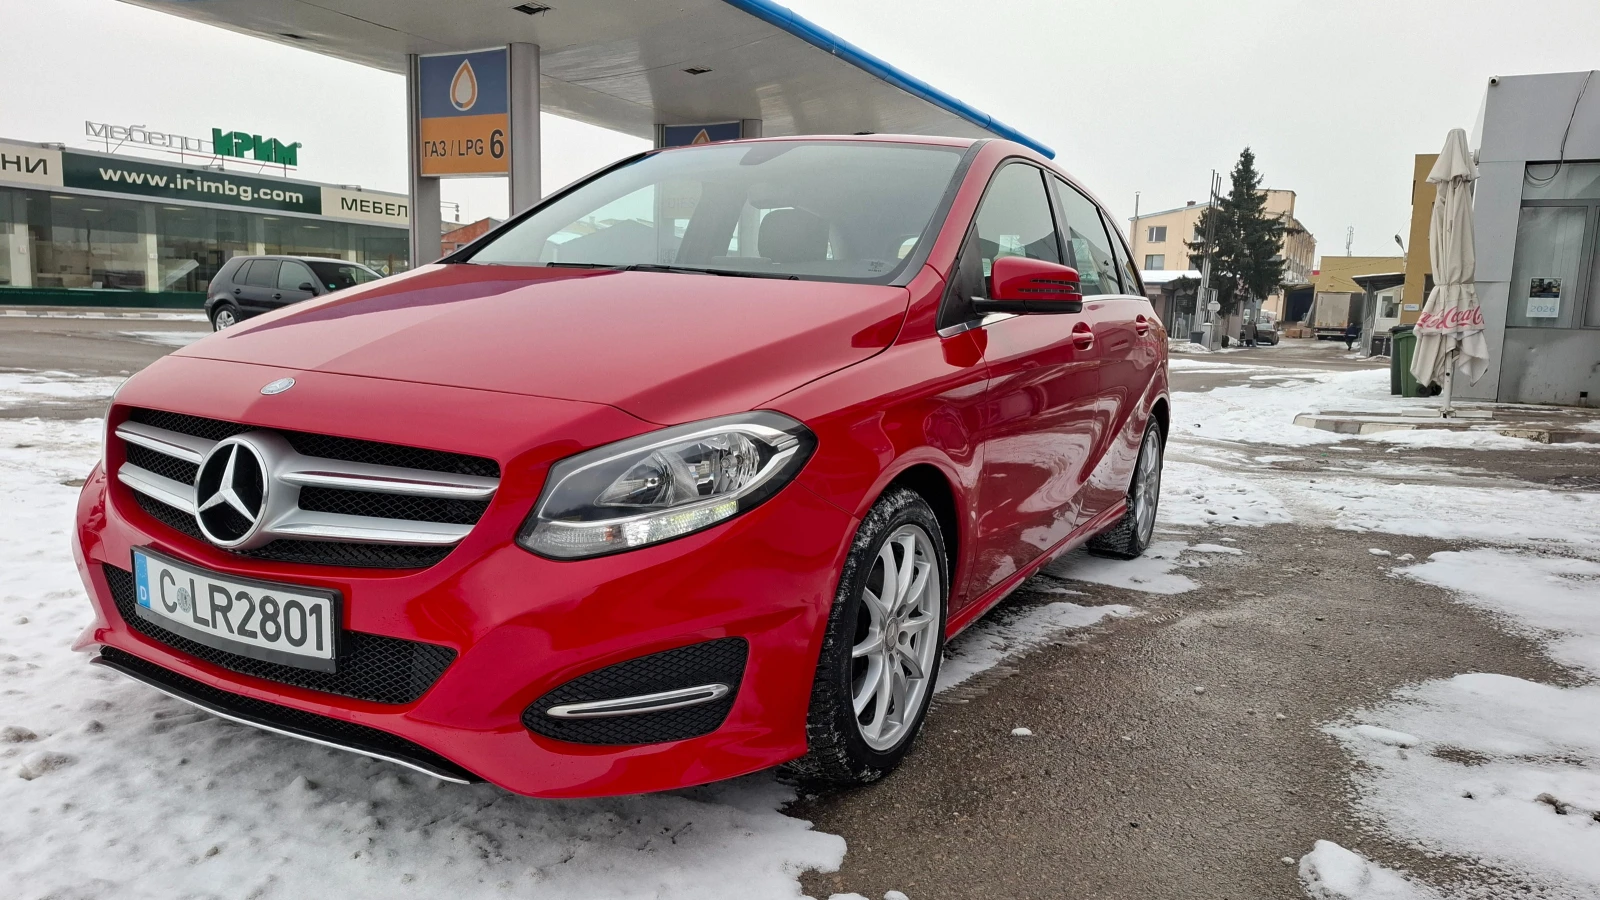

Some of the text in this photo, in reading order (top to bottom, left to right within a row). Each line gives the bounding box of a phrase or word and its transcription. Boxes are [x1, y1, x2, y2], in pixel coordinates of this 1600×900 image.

[424, 140, 447, 158] ГАЗ
[458, 138, 484, 156] LPG
[489, 128, 505, 159] 6
[1, 153, 48, 176] НИ
[98, 167, 304, 205] www.irimbg.com
[341, 196, 408, 218] МЕБЕЛ
[1530, 305, 1556, 313] 2026
[139, 585, 147, 601] D
[159, 568, 178, 614] C
